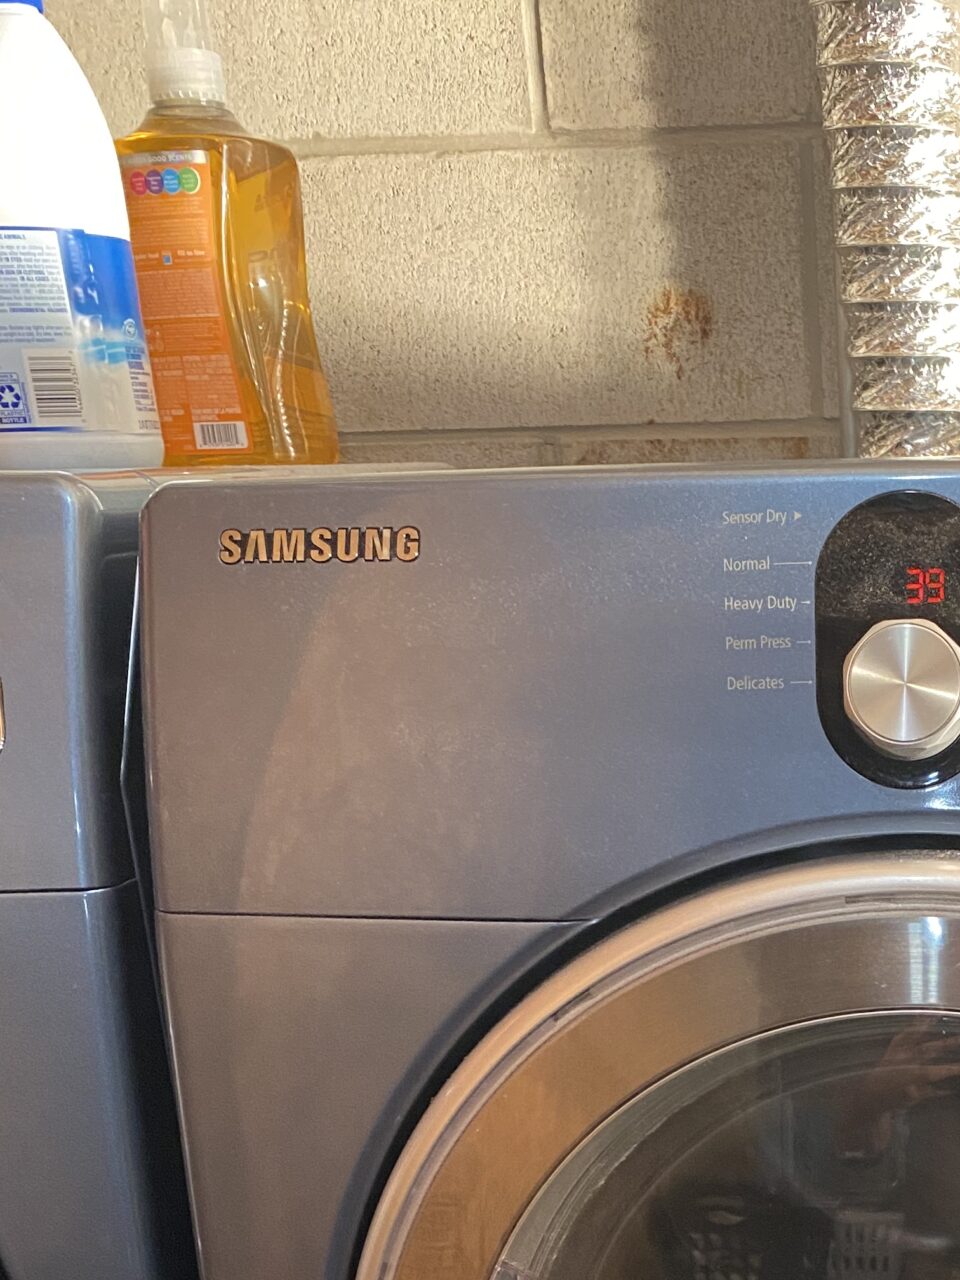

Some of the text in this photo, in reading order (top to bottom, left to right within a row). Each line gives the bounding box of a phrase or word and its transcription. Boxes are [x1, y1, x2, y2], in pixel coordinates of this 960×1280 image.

[722, 509, 787, 526] Sensor Dry
[219, 526, 421, 565] SAMSUNG
[723, 556, 770, 571] Normal
[905, 567, 945, 604] 39
[724, 595, 797, 613] Heavy Duty
[726, 635, 791, 650] Perm Press
[727, 675, 785, 690] Delicates
